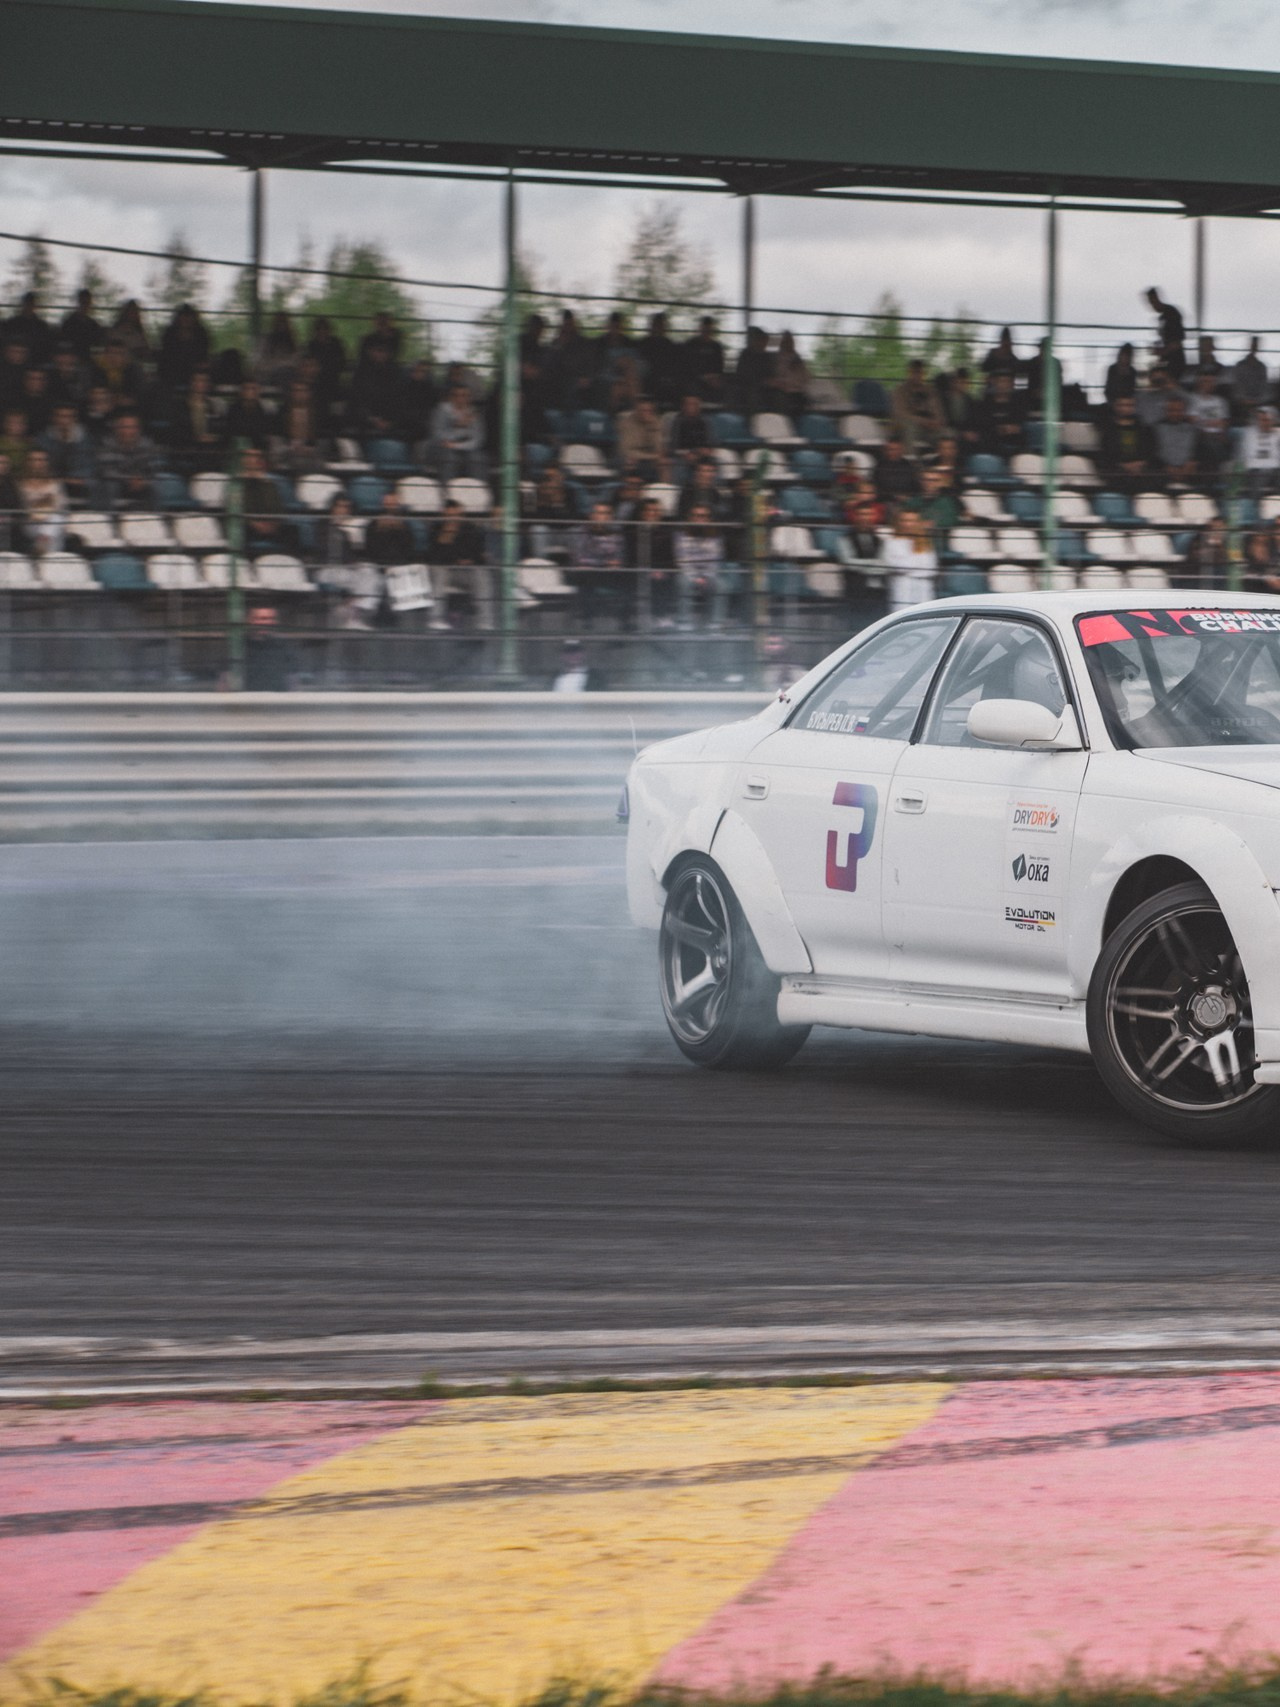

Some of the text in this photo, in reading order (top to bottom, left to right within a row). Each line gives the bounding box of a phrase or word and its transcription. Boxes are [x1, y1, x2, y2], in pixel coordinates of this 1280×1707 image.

[1013, 809, 1050, 826] DRYDRY
[1005, 906, 1056, 921] EVOLUTION
[1015, 923, 1035, 931] MOTOR
